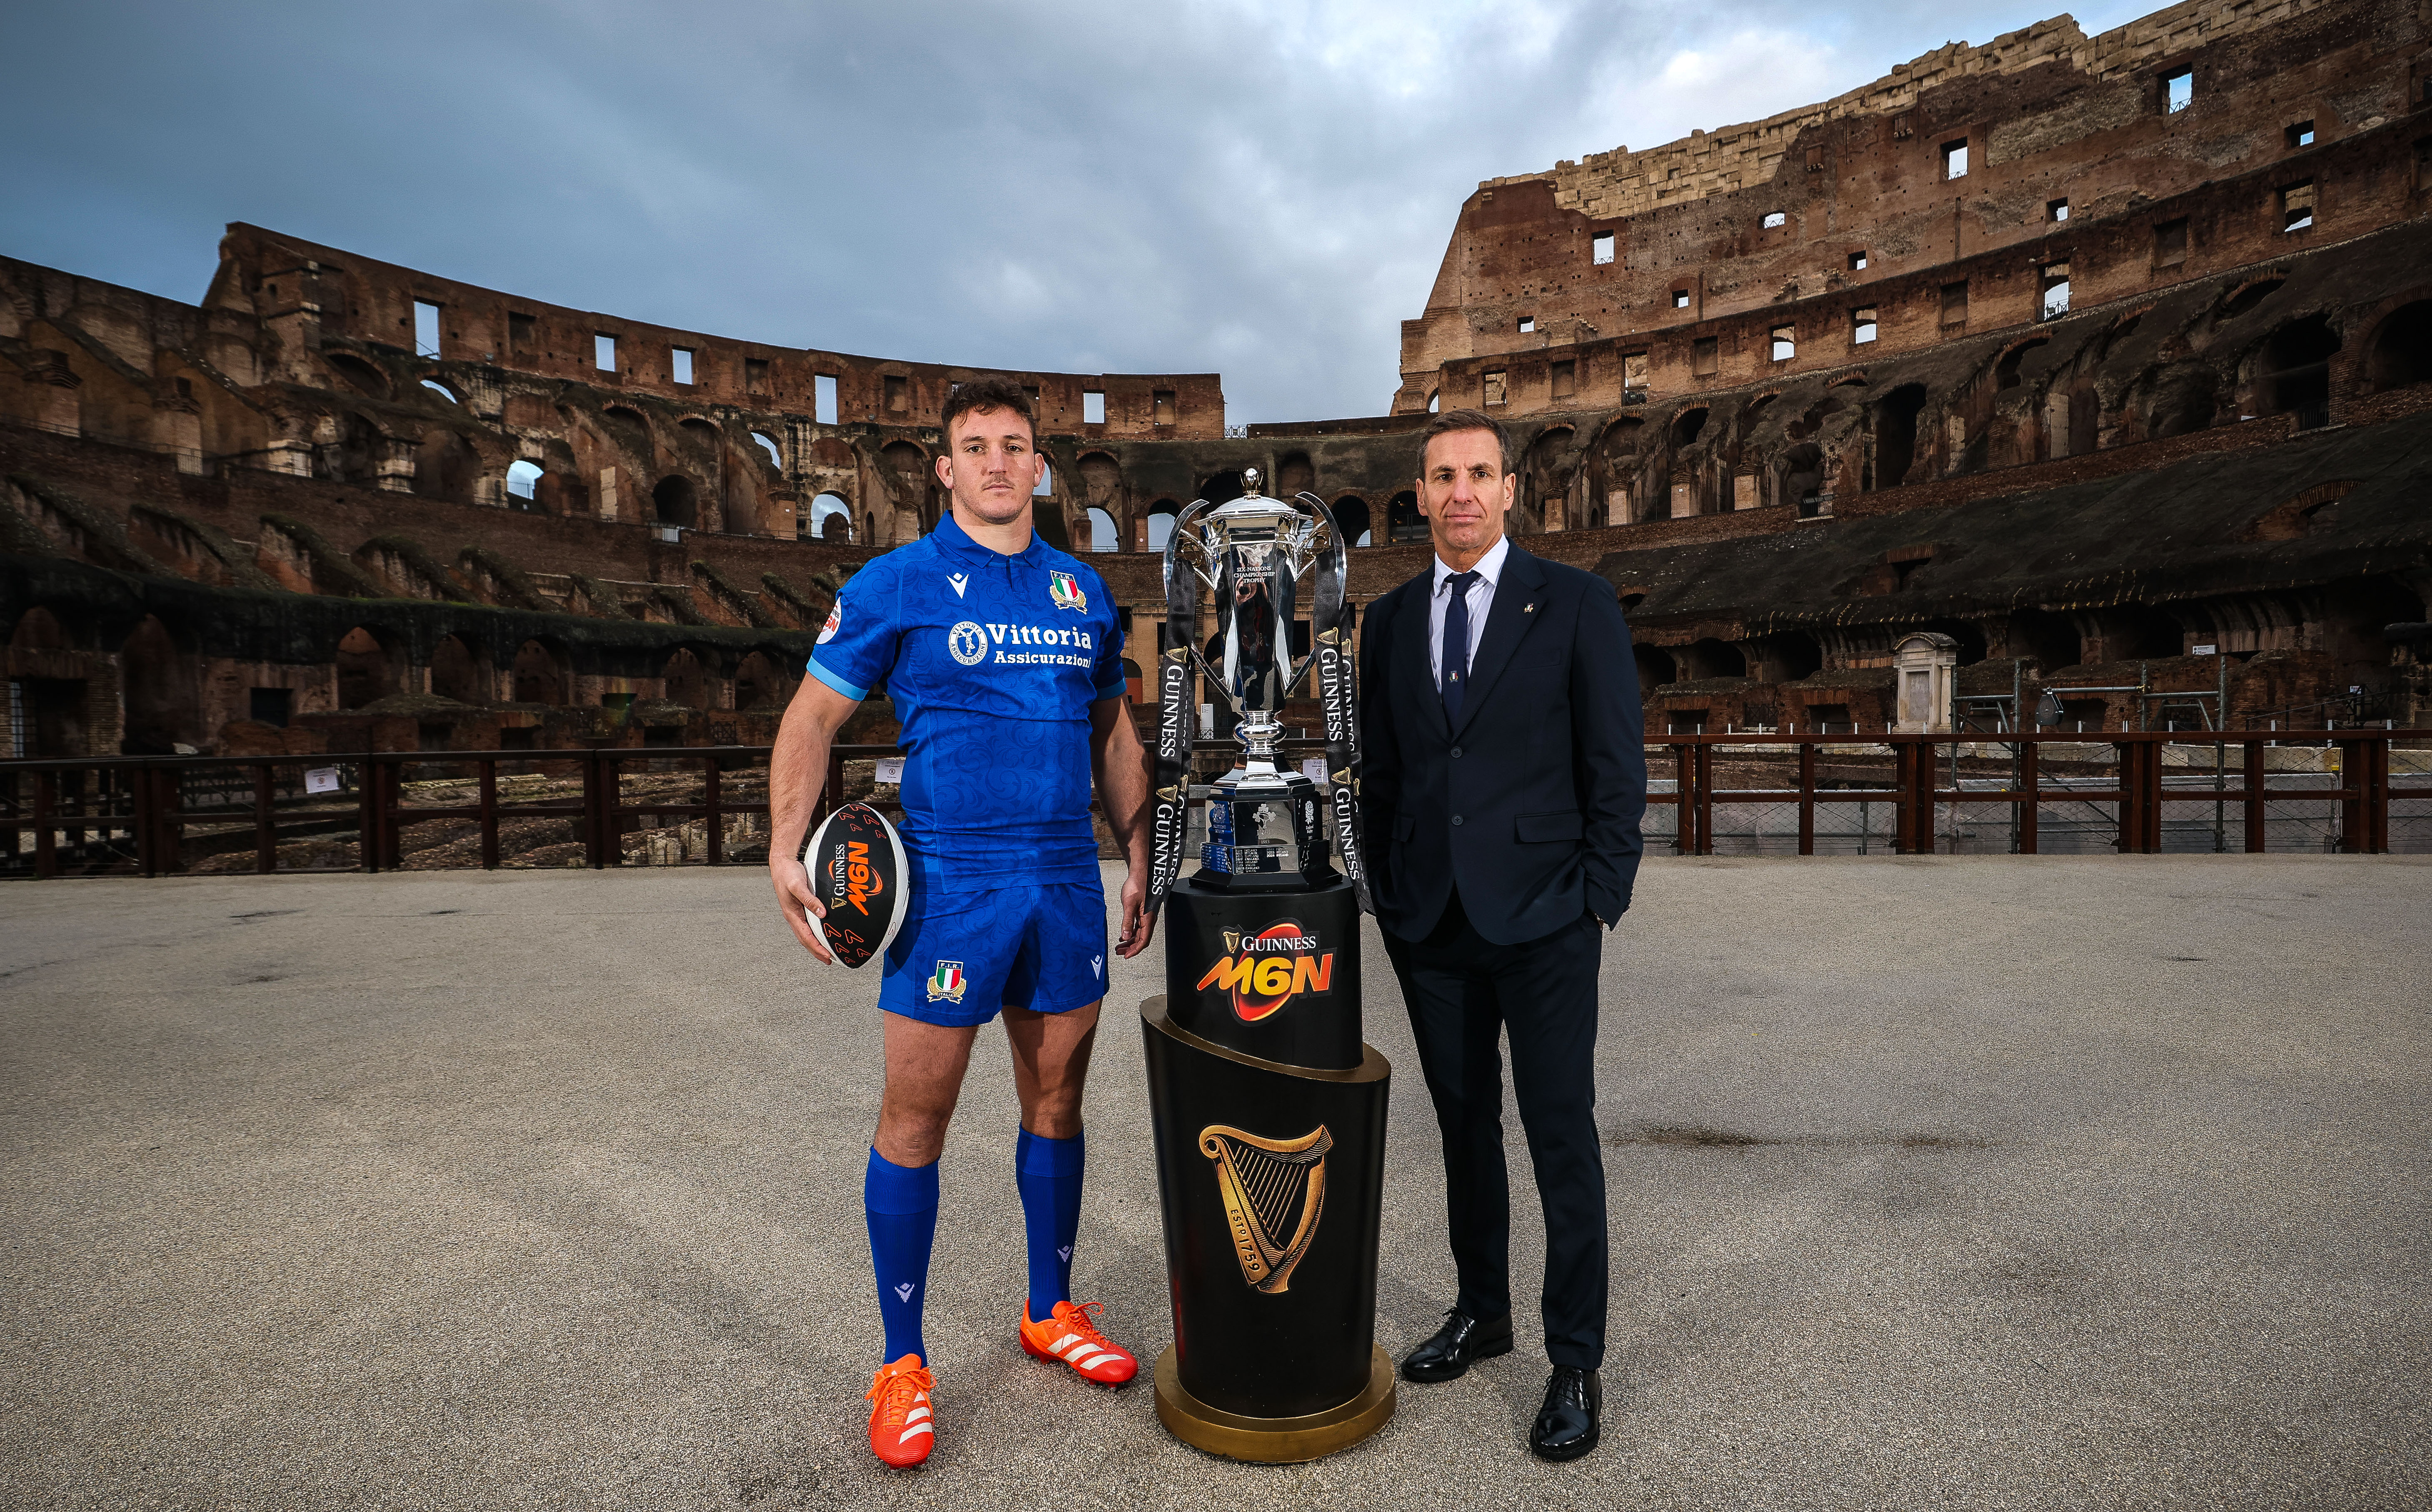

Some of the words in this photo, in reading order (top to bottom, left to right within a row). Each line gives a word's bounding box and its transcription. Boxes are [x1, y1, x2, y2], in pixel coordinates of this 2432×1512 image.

[824, 615, 839, 632] 6N
[952, 623, 982, 635] VITTORIA
[986, 624, 1092, 650] Vittoria
[951, 643, 986, 663] ASSICURAZIONI
[994, 651, 1091, 668] Assicurazioni
[1160, 665, 1184, 757] GUINNESS
[1321, 648, 1343, 741] GUINNESS
[1151, 803, 1174, 895] GUINNESS
[1336, 788, 1360, 880] GUINNESS
[834, 844, 845, 896] GUINNESS
[848, 841, 869, 916] M6N
[1241, 936, 1316, 951] GUINNESS
[1197, 953, 1333, 996] M6N
[1238, 1238, 1261, 1272] 1759
